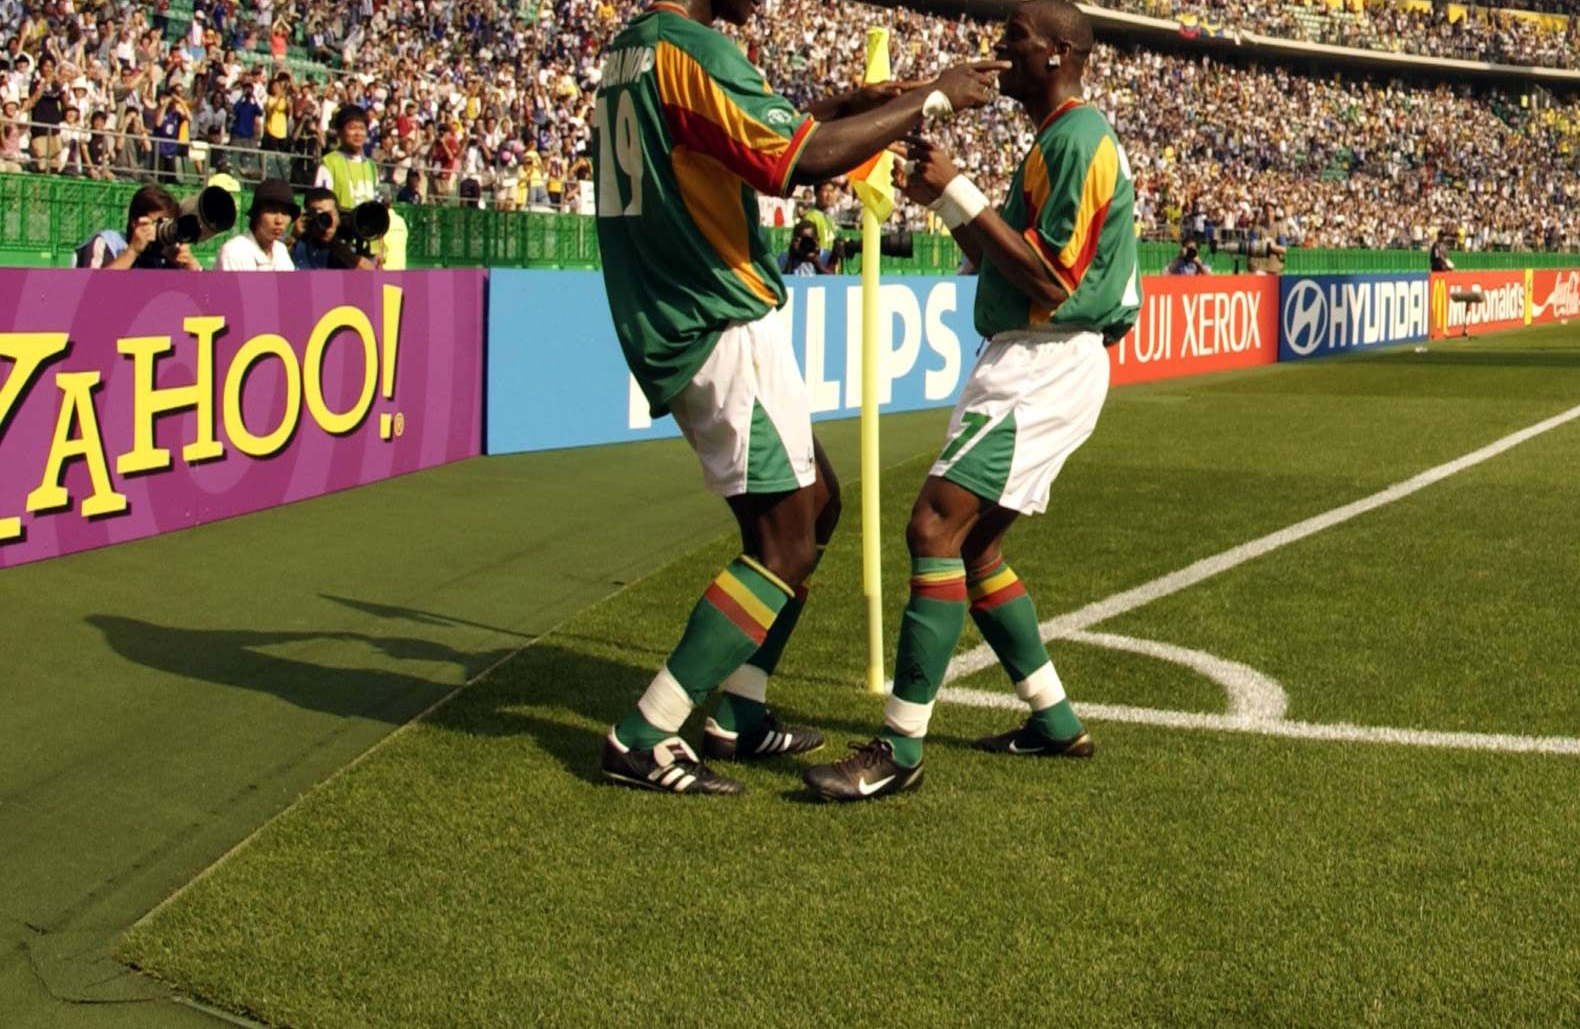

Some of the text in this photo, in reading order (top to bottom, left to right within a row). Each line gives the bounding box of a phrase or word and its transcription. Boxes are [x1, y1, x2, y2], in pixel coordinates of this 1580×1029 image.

[593, 89, 643, 217] 19
[1181, 290, 1262, 358] XEROX
[1328, 280, 1428, 348] HYUNDAI
[629, 282, 962, 430] LIPS
[939, 411, 992, 461] 7
